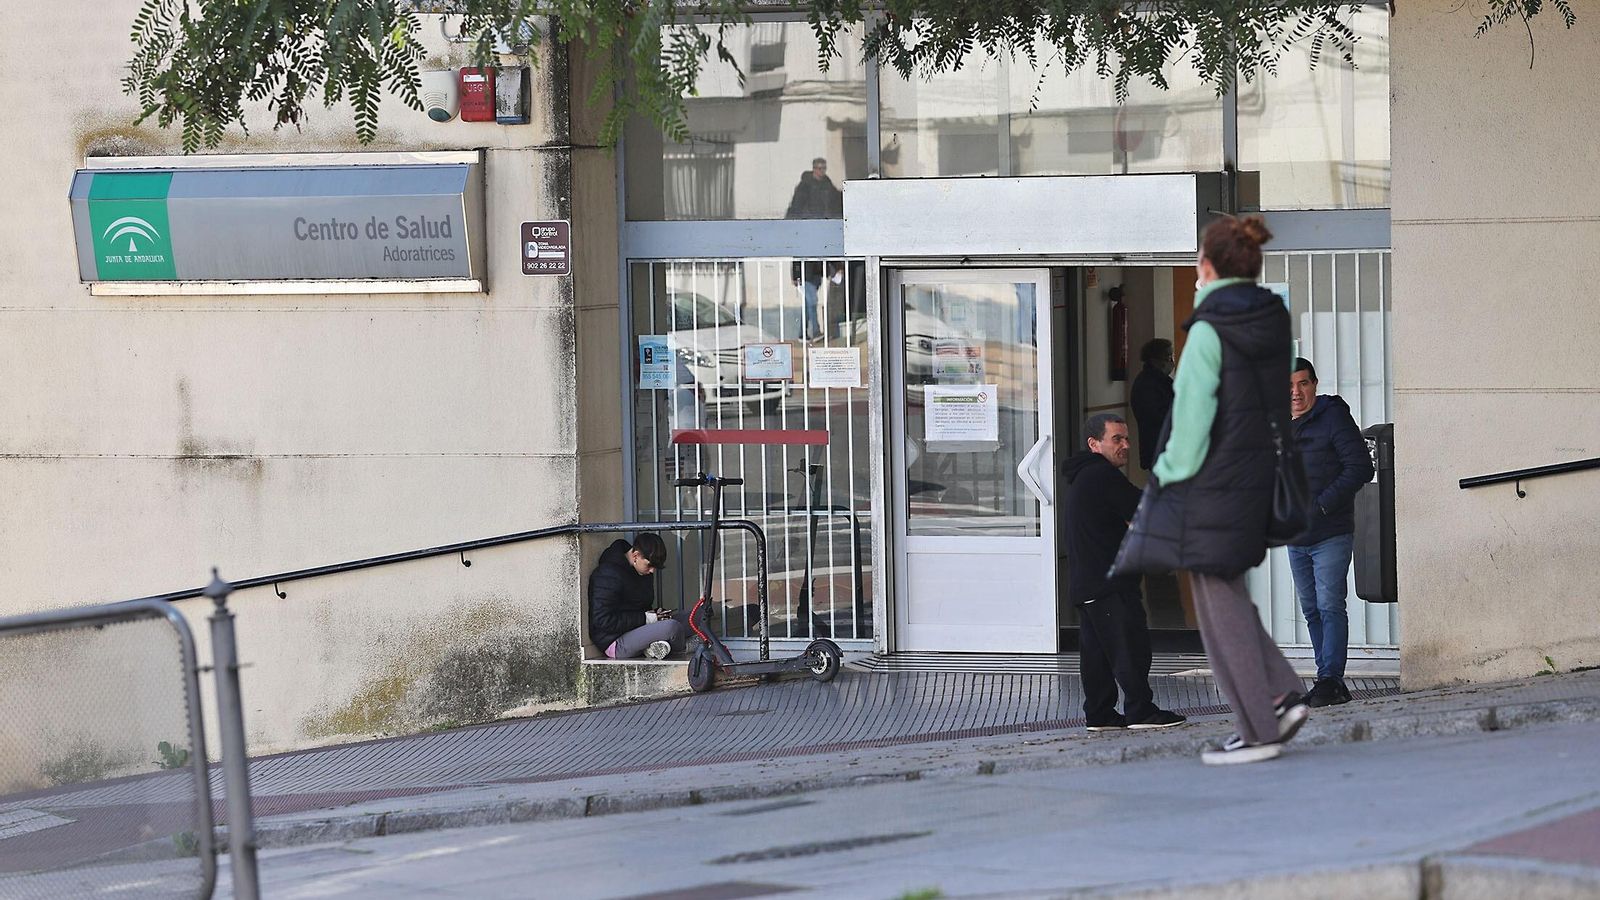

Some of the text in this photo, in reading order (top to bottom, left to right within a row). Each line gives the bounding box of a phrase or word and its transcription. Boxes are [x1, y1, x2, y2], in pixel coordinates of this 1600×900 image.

[293, 214, 453, 241] Centro de Salud
[105, 255, 165, 263] JUNTA DE ANDALUCIA
[383, 244, 455, 262] Adoratrices
